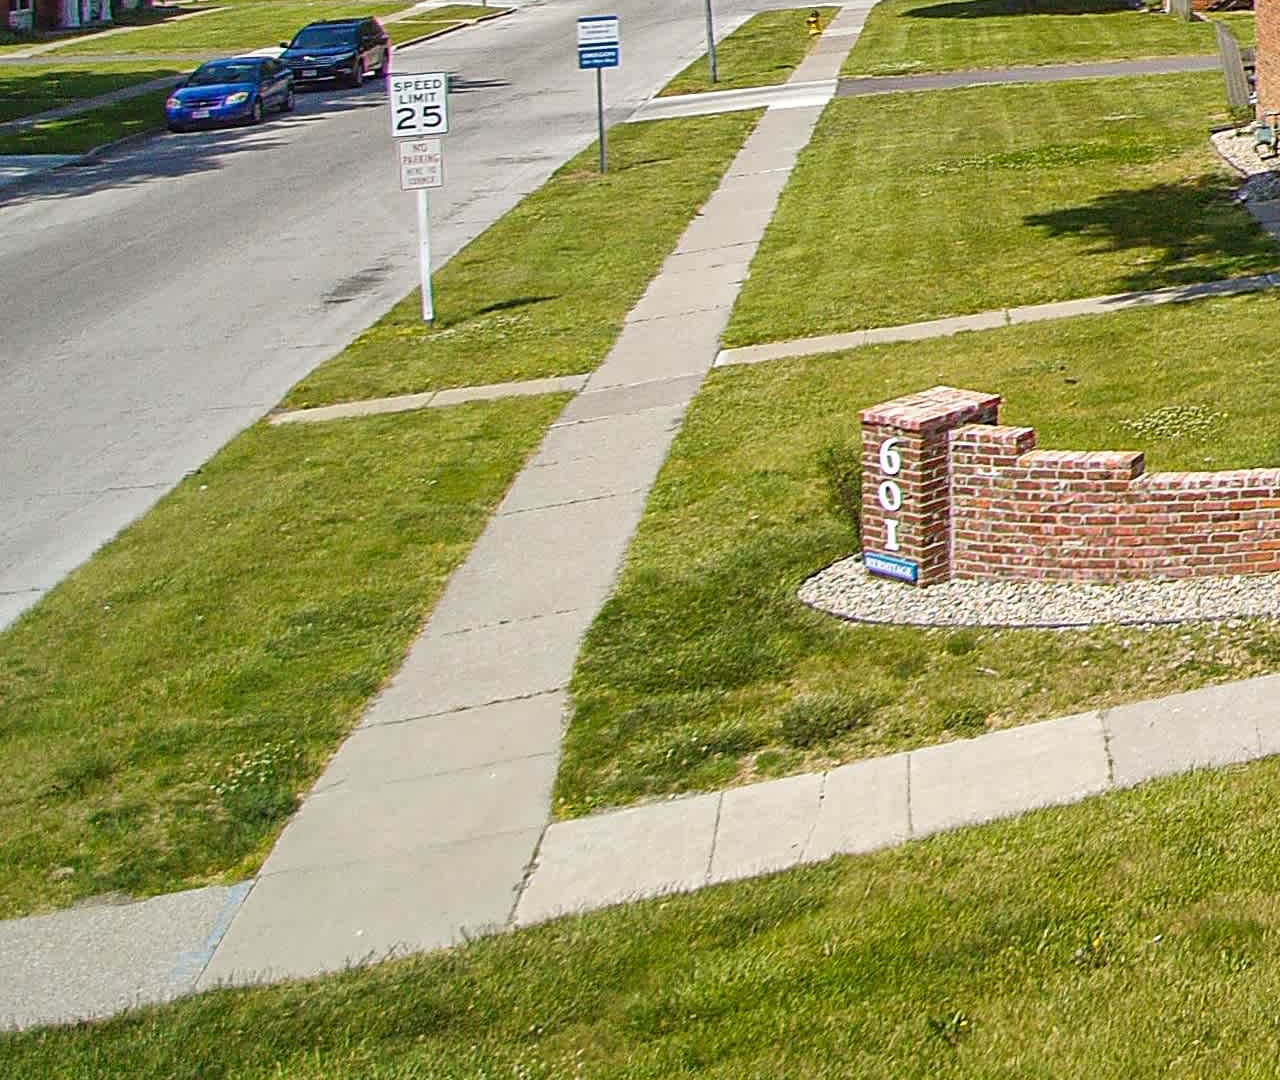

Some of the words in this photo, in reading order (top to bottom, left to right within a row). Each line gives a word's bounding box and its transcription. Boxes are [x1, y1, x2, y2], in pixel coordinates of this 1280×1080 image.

[394, 79, 442, 92] SPEED
[400, 92, 436, 105] LIMIT
[396, 105, 442, 130] 25
[402, 152, 440, 165] PARKING
